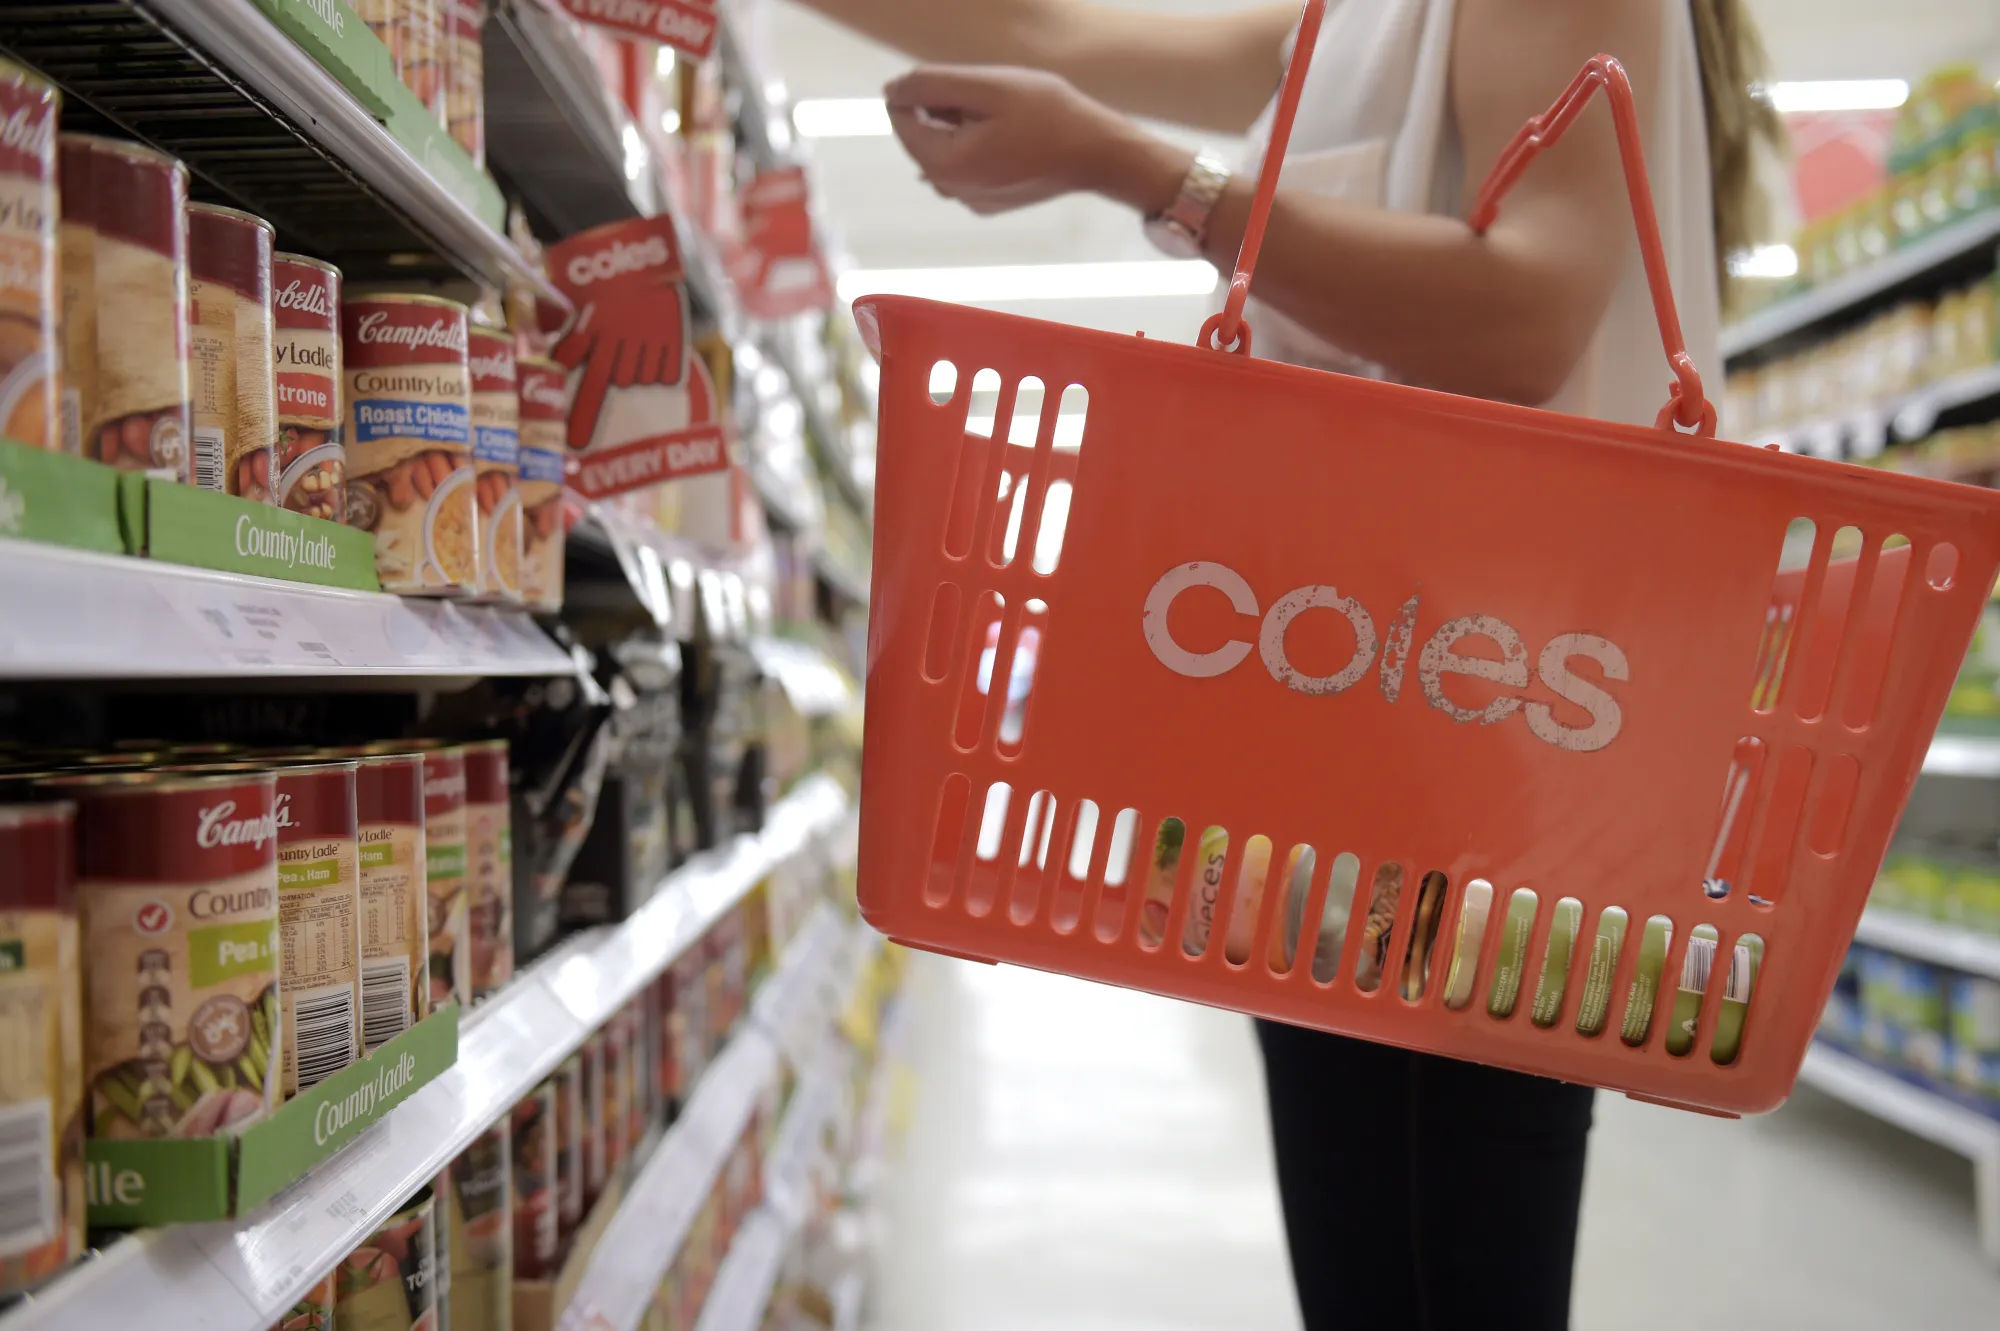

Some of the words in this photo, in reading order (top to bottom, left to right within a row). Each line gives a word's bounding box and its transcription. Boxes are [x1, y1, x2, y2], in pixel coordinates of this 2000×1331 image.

[567, 236, 669, 286] coles
[290, 342, 333, 369] Ladle
[278, 384, 327, 407] trone
[354, 372, 433, 395] Country
[360, 406, 412, 424] Roast
[666, 437, 719, 470] DAY
[234, 514, 300, 568] Country
[299, 522, 336, 569] Ladle
[1143, 561, 1630, 752] coles
[366, 829, 392, 842] Ladle
[312, 845, 338, 858] Ladle
[307, 869, 330, 880] Ham
[219, 940, 258, 966] Pea
[314, 1079, 378, 1146] Country
[378, 1051, 415, 1102] Ladle
